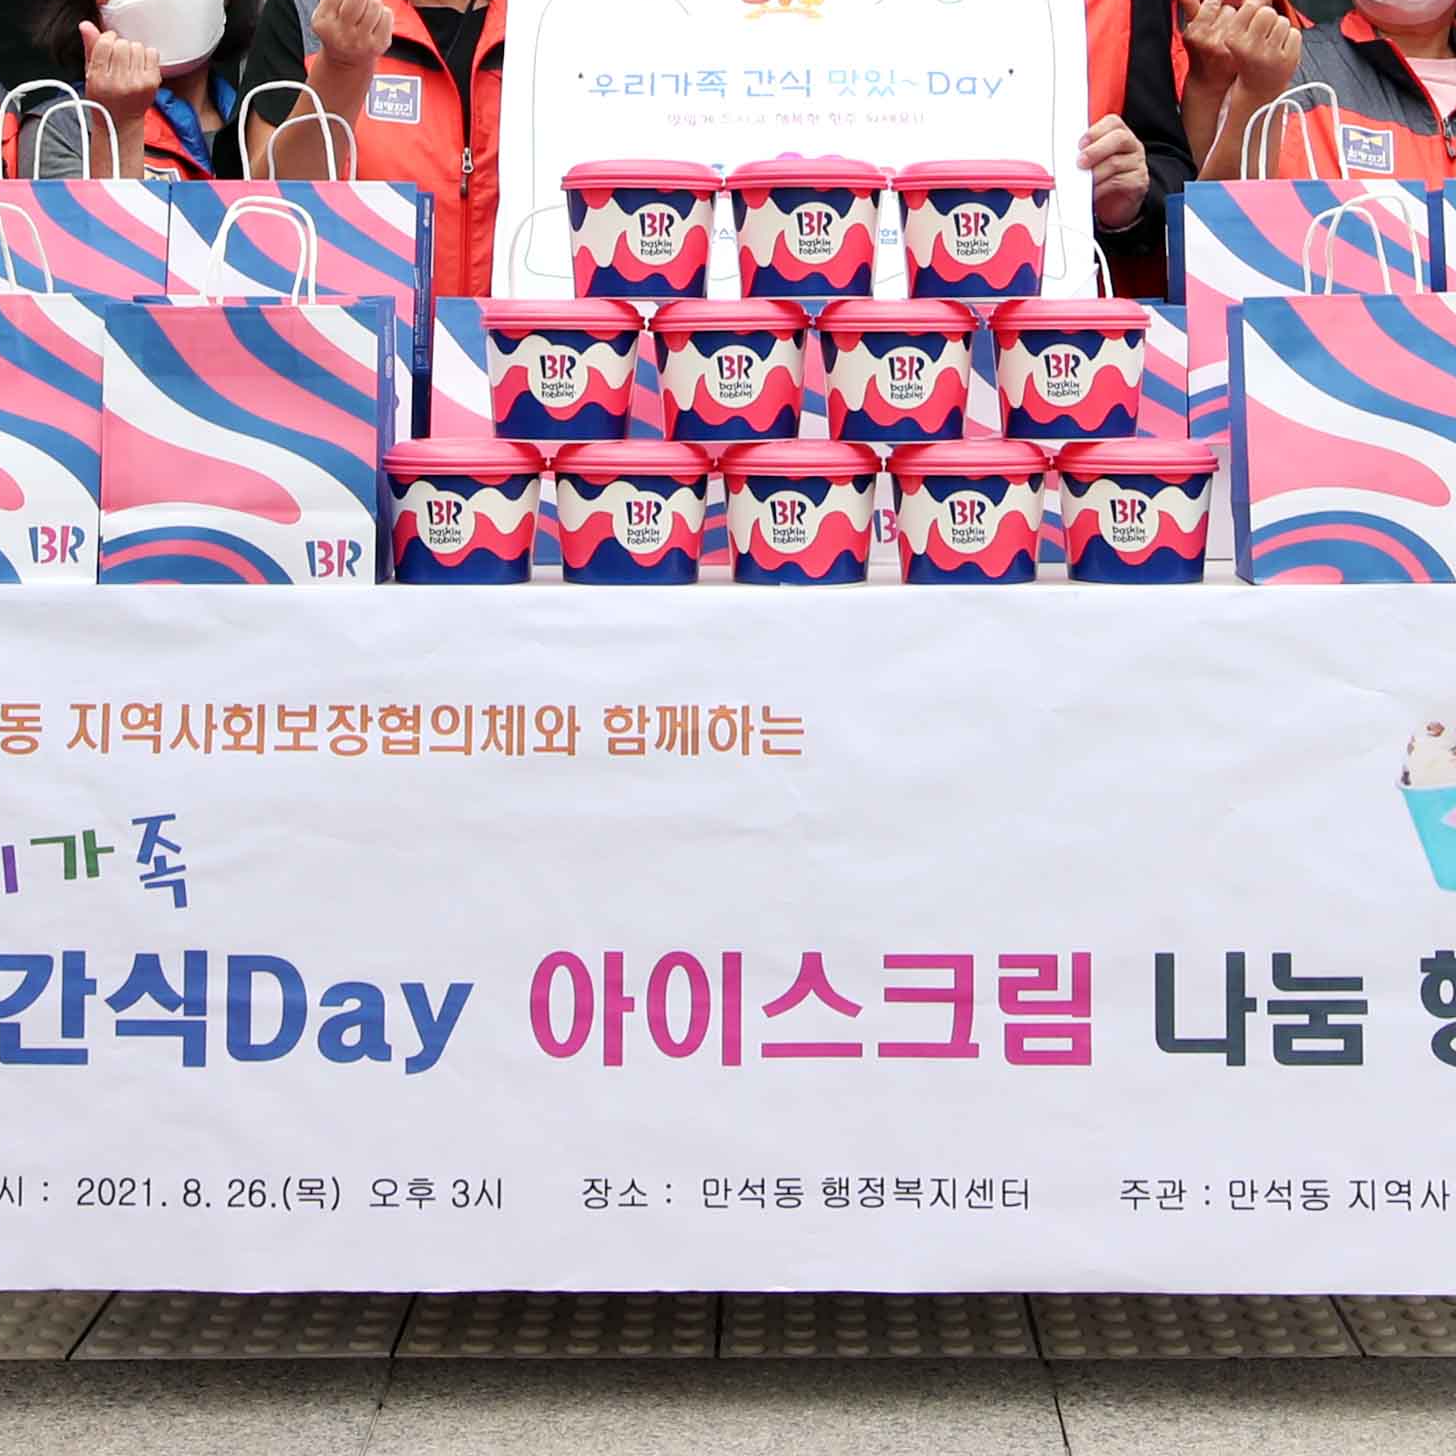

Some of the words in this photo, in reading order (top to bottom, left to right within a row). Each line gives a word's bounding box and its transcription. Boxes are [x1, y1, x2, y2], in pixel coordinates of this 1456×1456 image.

[743, 68, 812, 97] 간식
[639, 212, 675, 237] BR
[796, 211, 832, 236] BR
[953, 212, 989, 237] BR
[539, 355, 575, 380] BR
[717, 355, 753, 380] BR
[888, 356, 924, 381] BR
[1044, 354, 1080, 379] BR
[426, 500, 462, 525] BR
[625, 500, 661, 525] BR
[771, 500, 807, 525] BR
[949, 500, 985, 525] BR
[1109, 499, 1145, 524] BR
[28, 526, 85, 564] BR
[305, 539, 362, 578] BR
[66, 702, 581, 757] 지역사회보장협의체와
[603, 704, 805, 757] 함께하는
[529, 950, 1093, 1067] 아이스크림
[1154, 951, 1369, 1067] 나눔
[369, 1177, 436, 1210] 오후
[451, 1177, 502, 1210] 3시
[702, 1177, 804, 1210] 만석동
[821, 1176, 1030, 1211] 행정복지센터
[1228, 1178, 1331, 1212] 만석동
